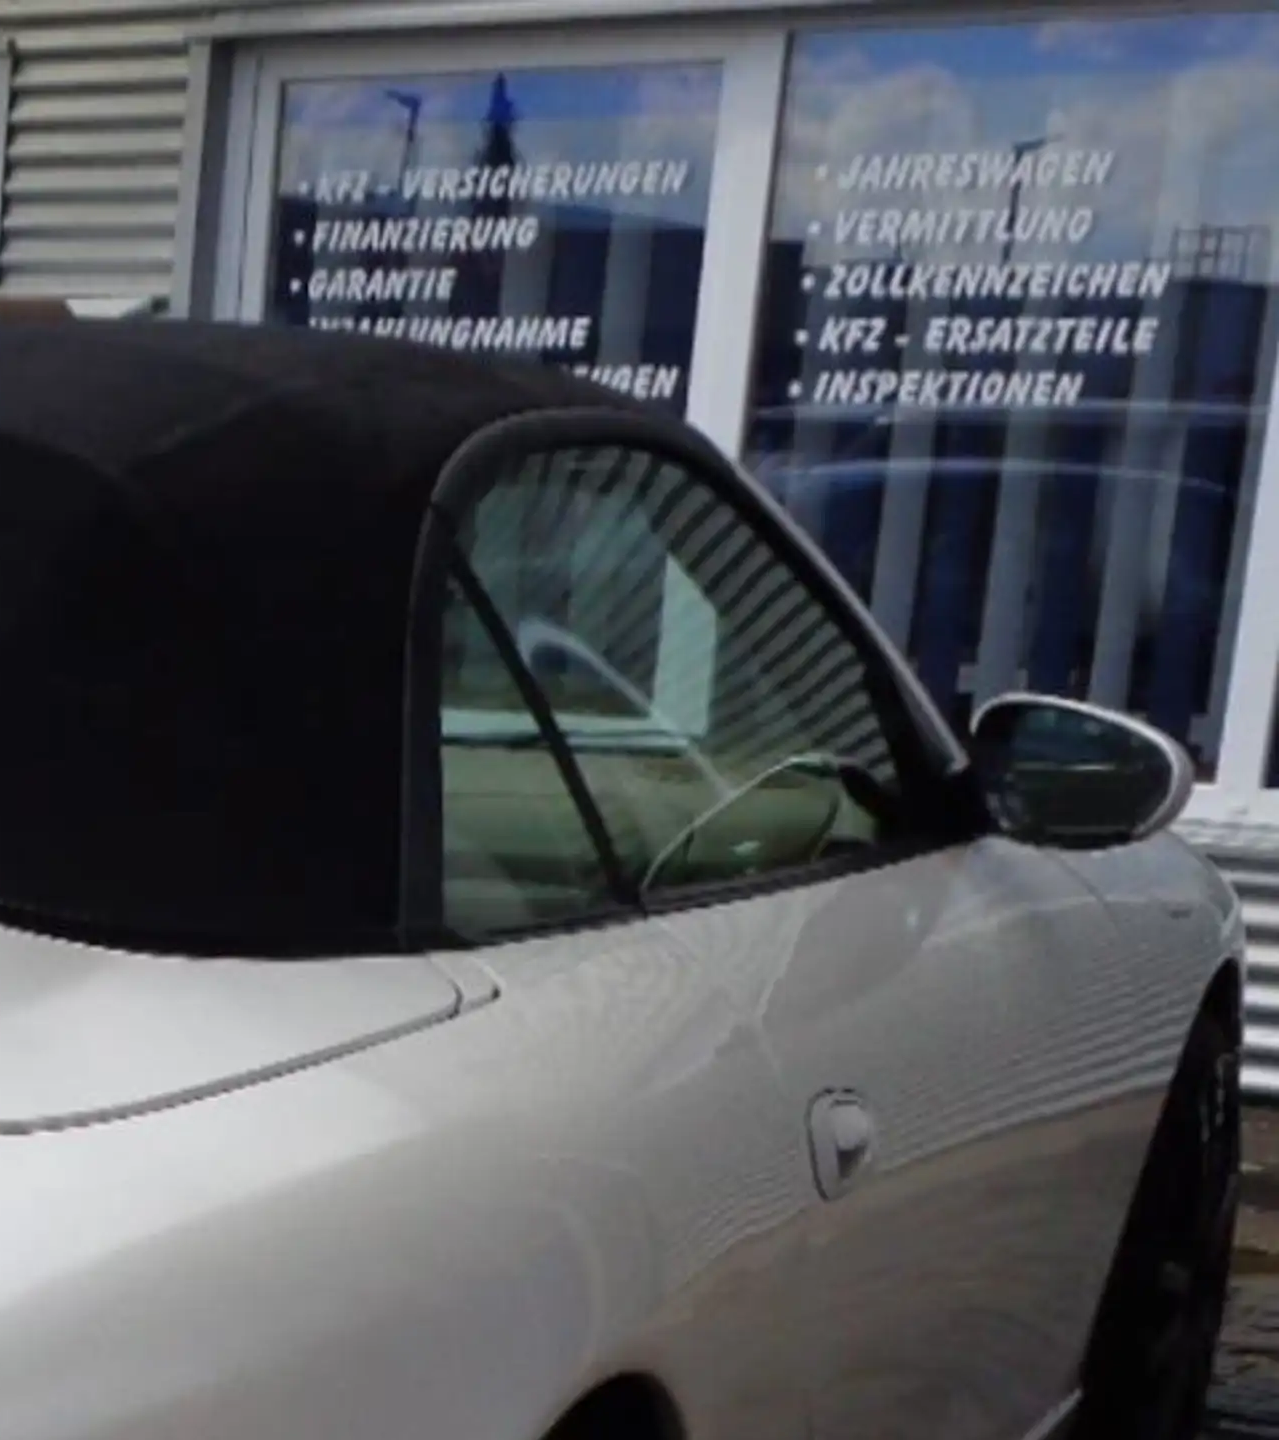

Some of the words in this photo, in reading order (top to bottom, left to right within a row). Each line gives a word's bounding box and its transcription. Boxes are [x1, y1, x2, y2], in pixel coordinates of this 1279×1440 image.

[314, 170, 369, 205] KFZ
[402, 161, 689, 199] VERSICHERUNGEN
[836, 150, 1115, 190] JAHRESWAGEN
[312, 216, 539, 253] FINANZIERUNG
[833, 207, 1094, 246] VERMITTLUNG
[307, 269, 458, 302] GARANTIE
[824, 262, 1172, 300] ZOLLKENNZEICHEN
[817, 317, 889, 354] KFZ
[923, 317, 1160, 354] ERSATZTEILE
[812, 371, 1085, 408] INSPEKTIONEN
